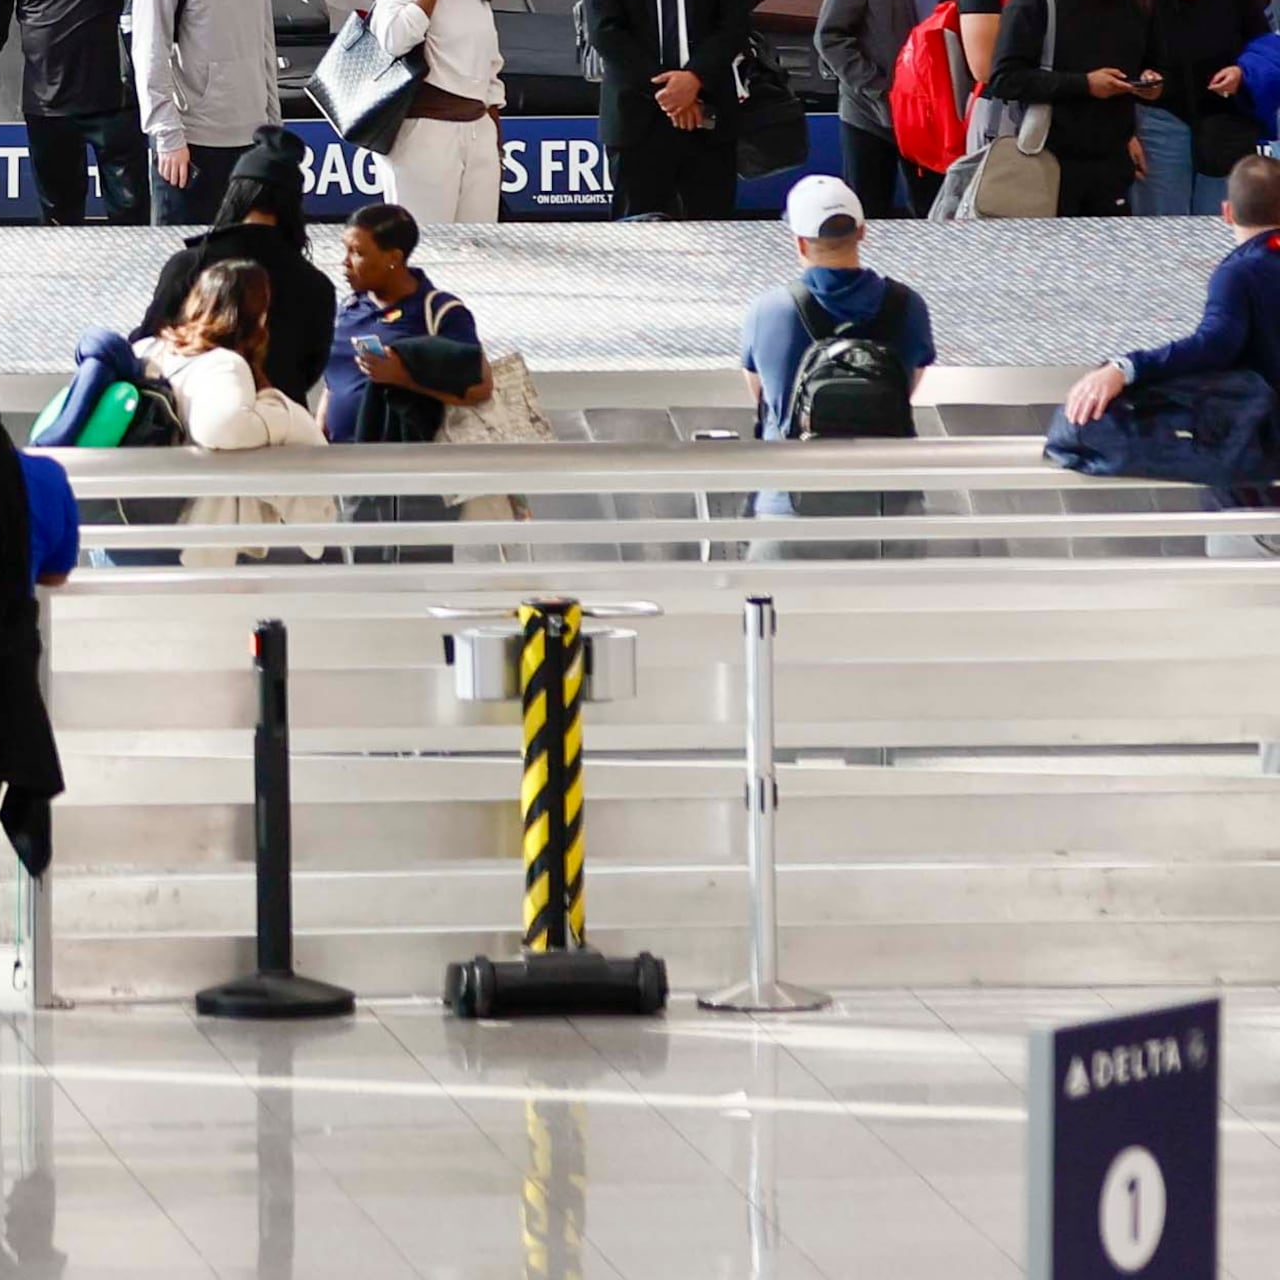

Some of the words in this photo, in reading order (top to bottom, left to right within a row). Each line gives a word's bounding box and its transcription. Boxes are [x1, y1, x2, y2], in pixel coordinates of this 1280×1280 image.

[551, 194, 574, 203] DELTA
[574, 194, 607, 204] FLIGHTS.
[1091, 1036, 1182, 1089] DELTA
[1125, 1176, 1139, 1245] 1
